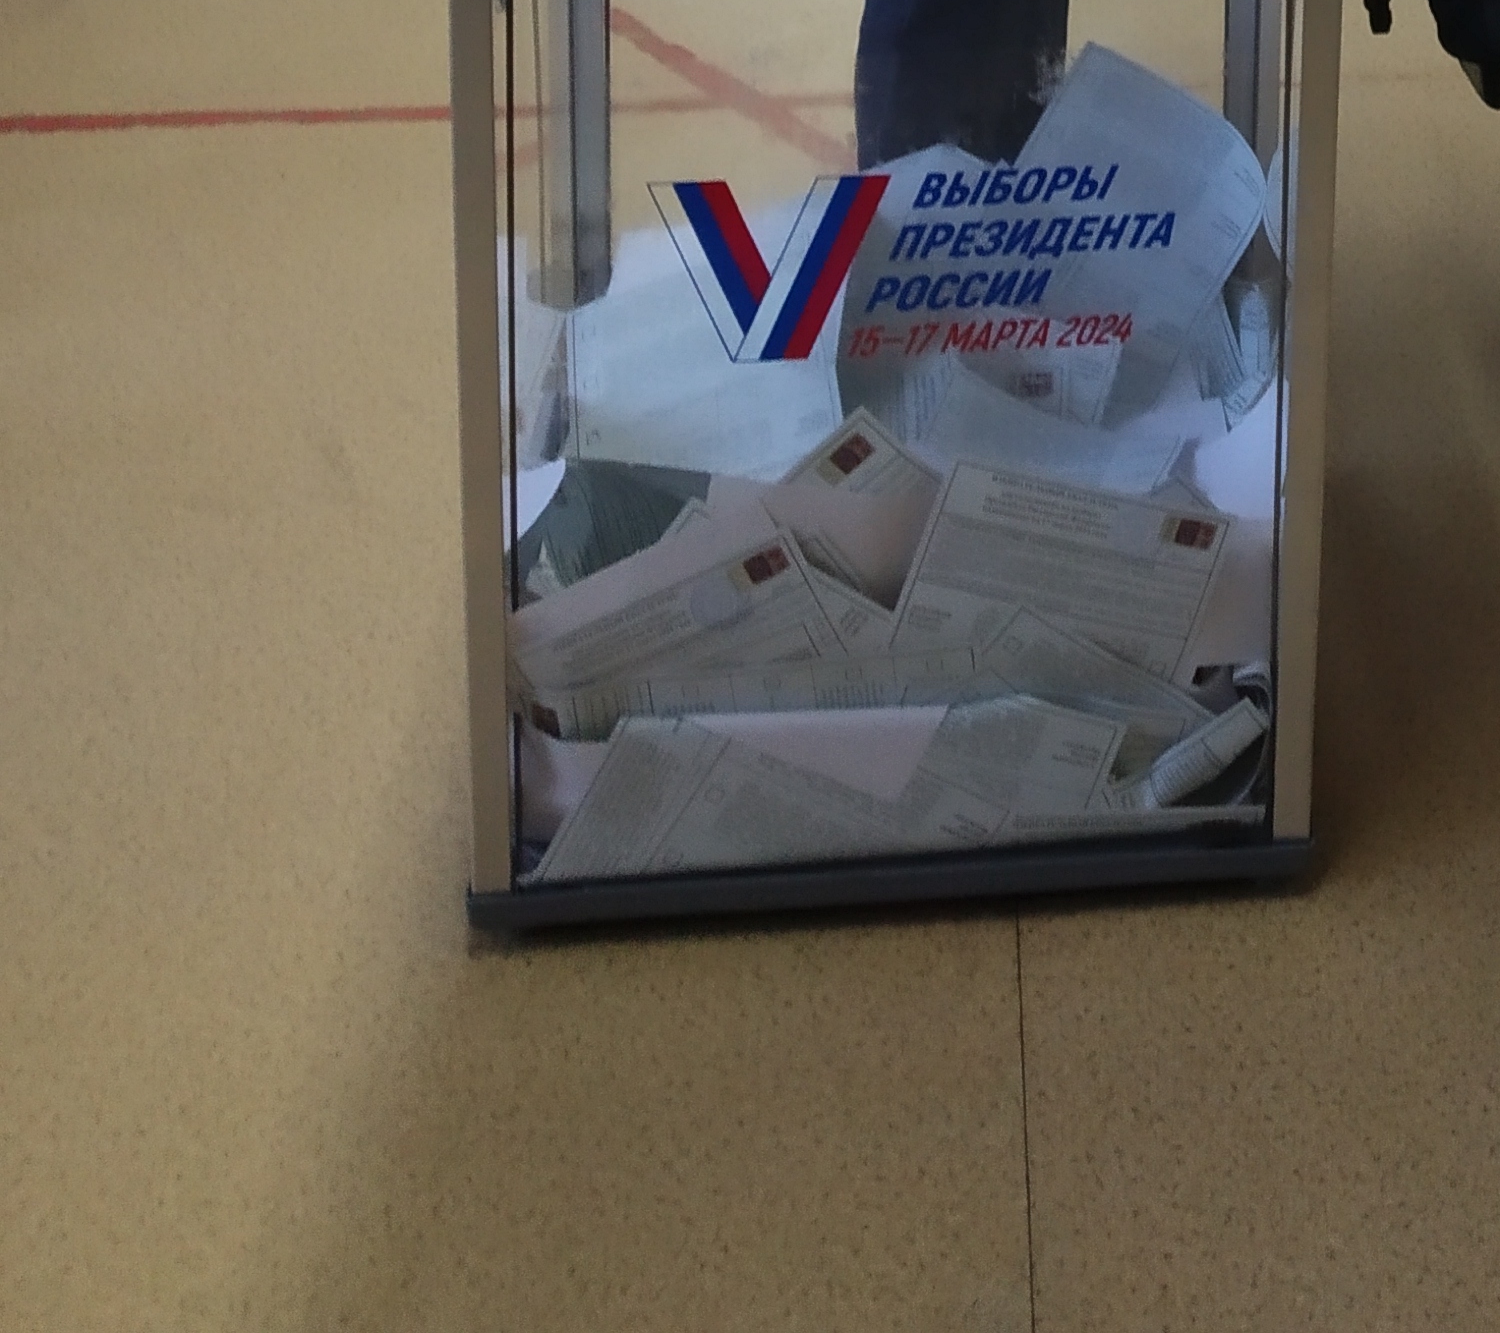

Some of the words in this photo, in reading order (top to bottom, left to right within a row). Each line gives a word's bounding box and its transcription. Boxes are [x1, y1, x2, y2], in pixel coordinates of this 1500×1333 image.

[912, 163, 1119, 209] ВЫБОРЫ
[889, 211, 1176, 262] ПРЕЗИДЕНТА
[865, 269, 1052, 313] РОССИИ
[941, 317, 1051, 354] МАРТА
[1056, 312, 1133, 349] 2024
